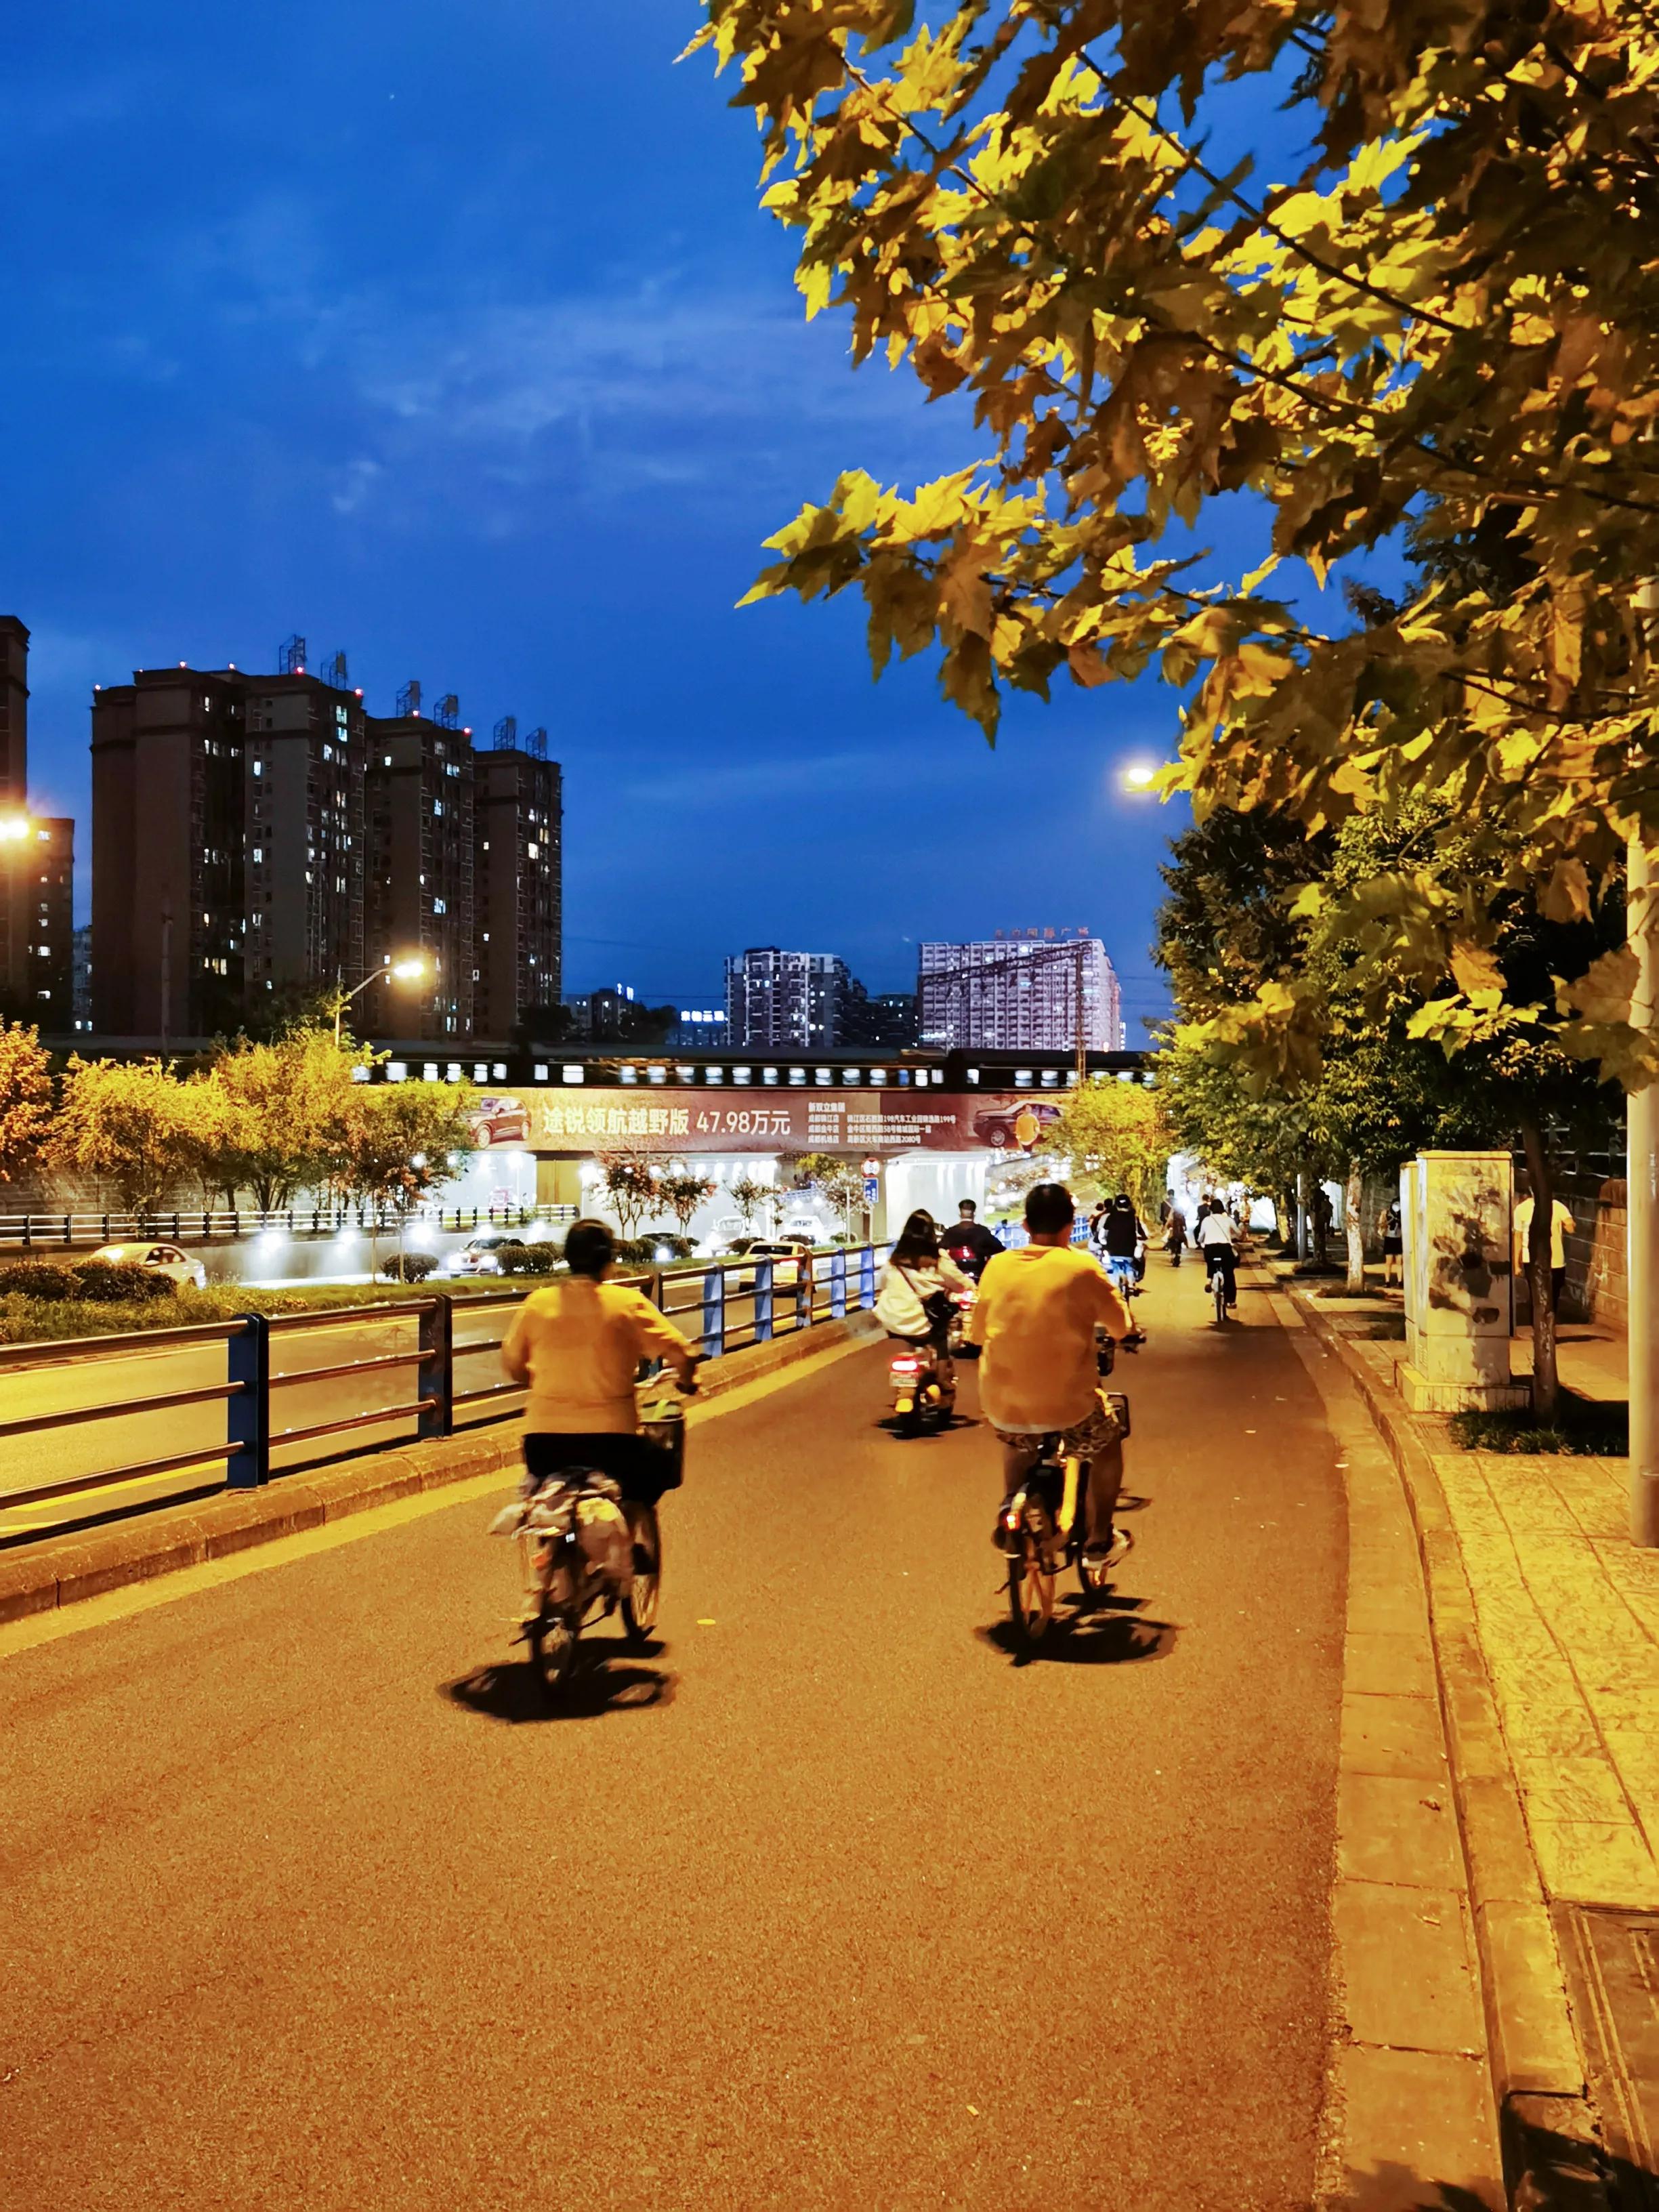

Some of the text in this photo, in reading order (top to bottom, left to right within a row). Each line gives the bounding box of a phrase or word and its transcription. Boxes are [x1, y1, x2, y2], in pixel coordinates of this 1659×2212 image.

[543, 1108, 791, 1135] 途锐领航越野版 47.98万元
